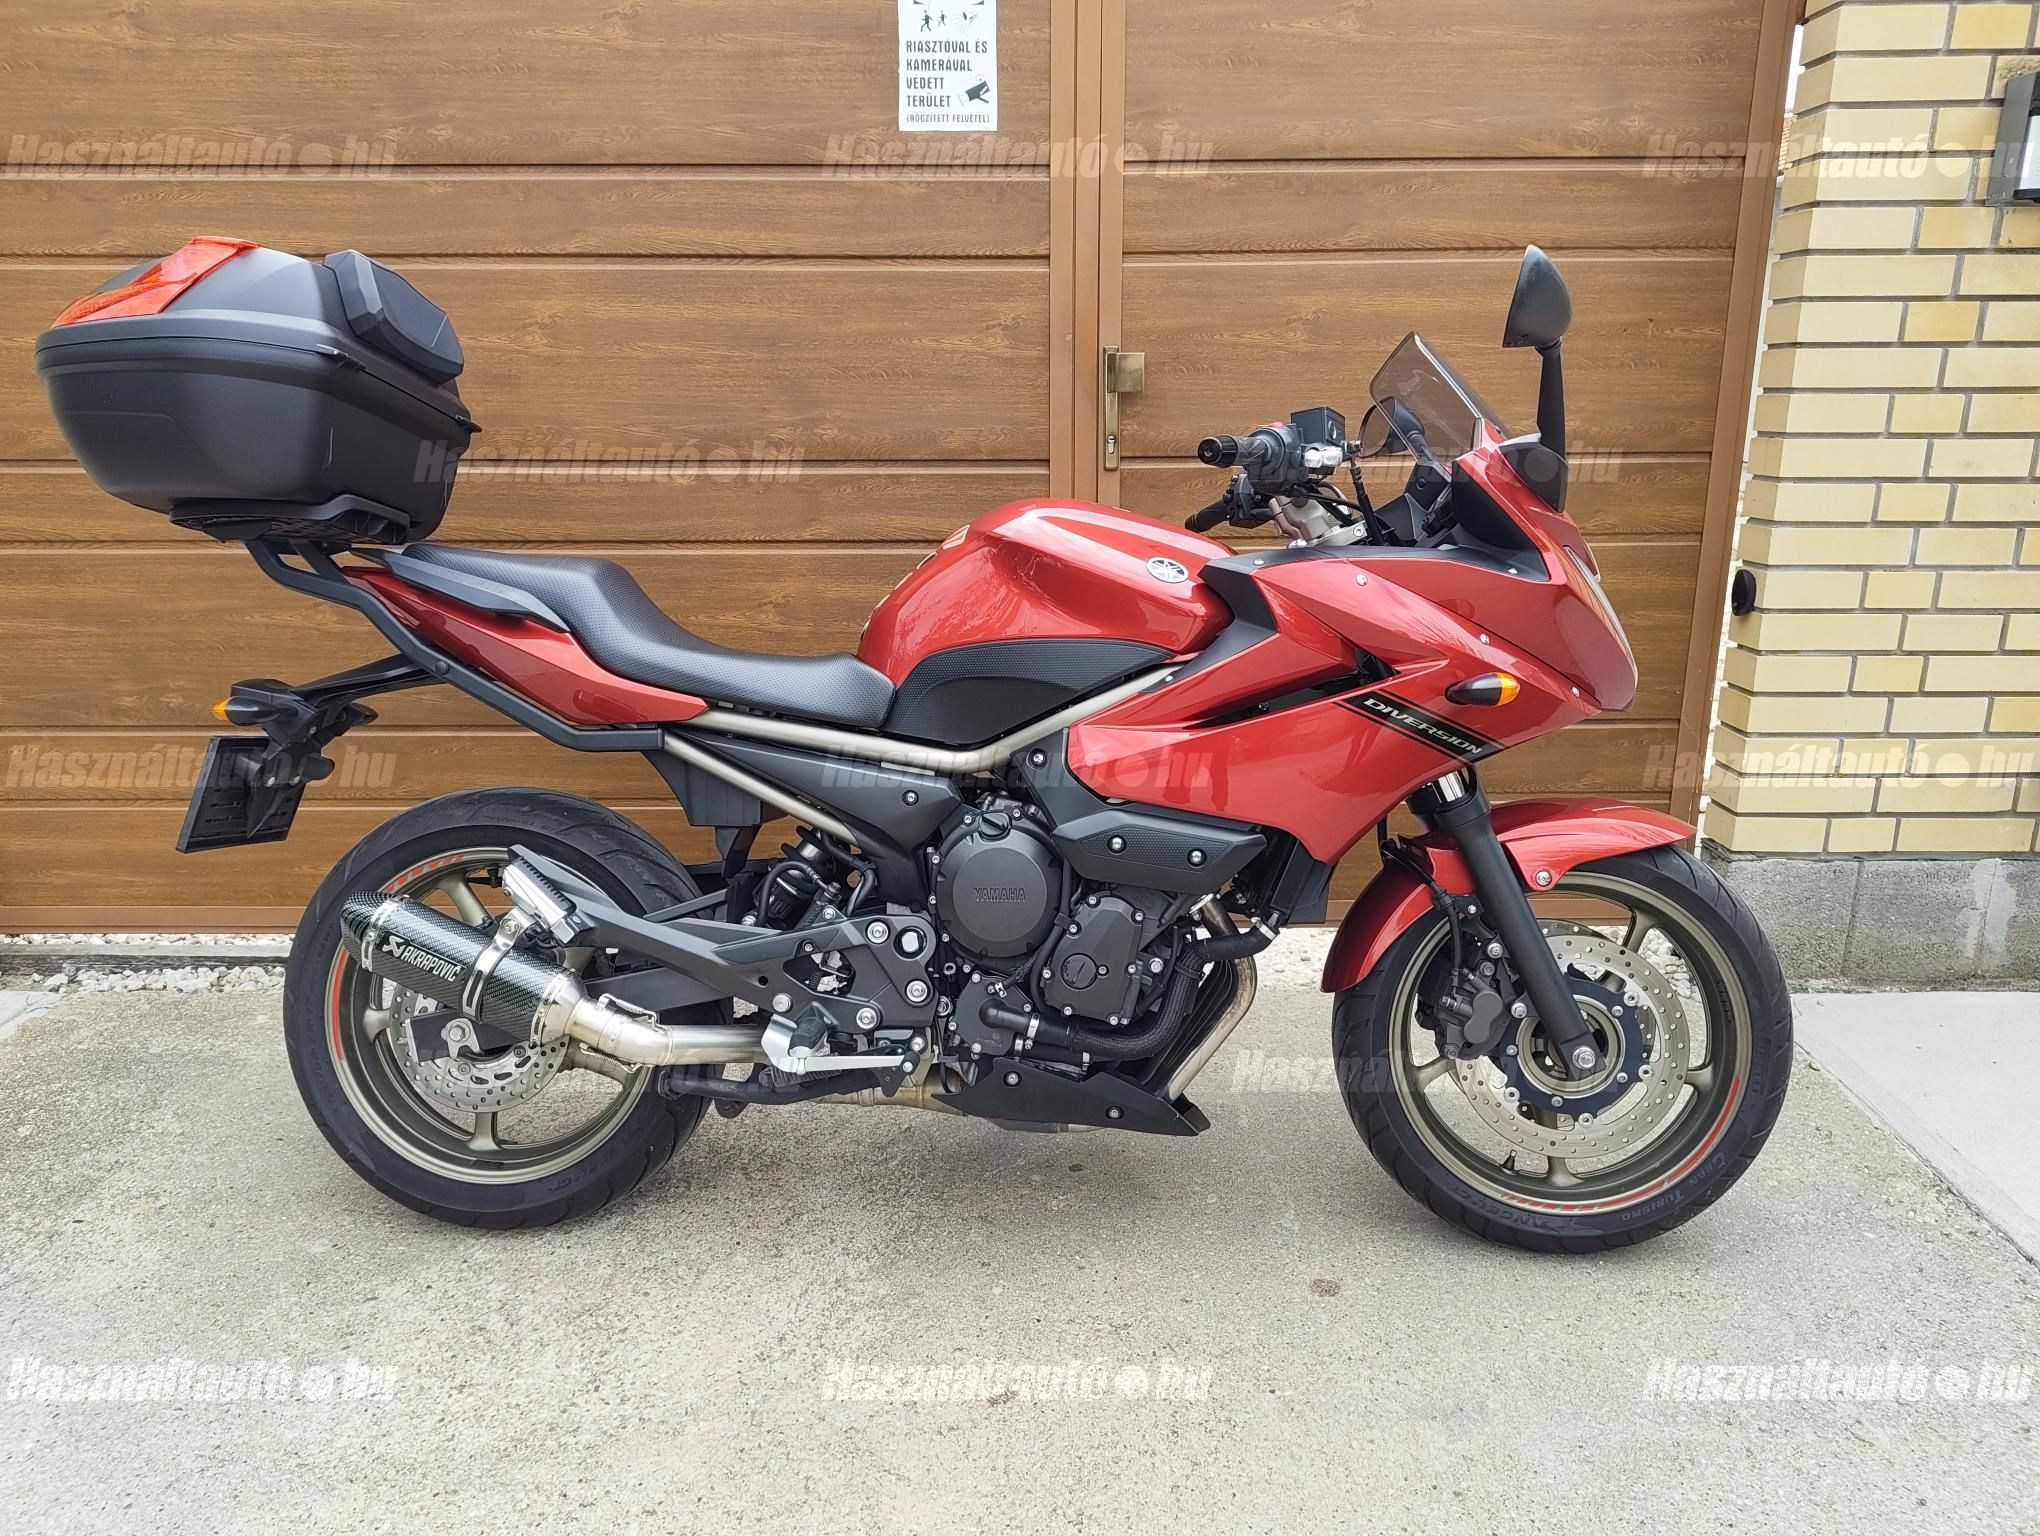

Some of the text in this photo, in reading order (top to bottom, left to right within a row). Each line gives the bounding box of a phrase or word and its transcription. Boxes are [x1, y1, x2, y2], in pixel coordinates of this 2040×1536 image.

[905, 37, 988, 53] RIASZTÓVAL ÉS
[905, 56, 972, 72] KAMERÁVAL
[905, 74, 945, 90] VÉDETT
[906, 92, 951, 108] TERÜLET
[1362, 697, 1483, 755] DIVERSION
[973, 886, 1027, 902] YAMAHA
